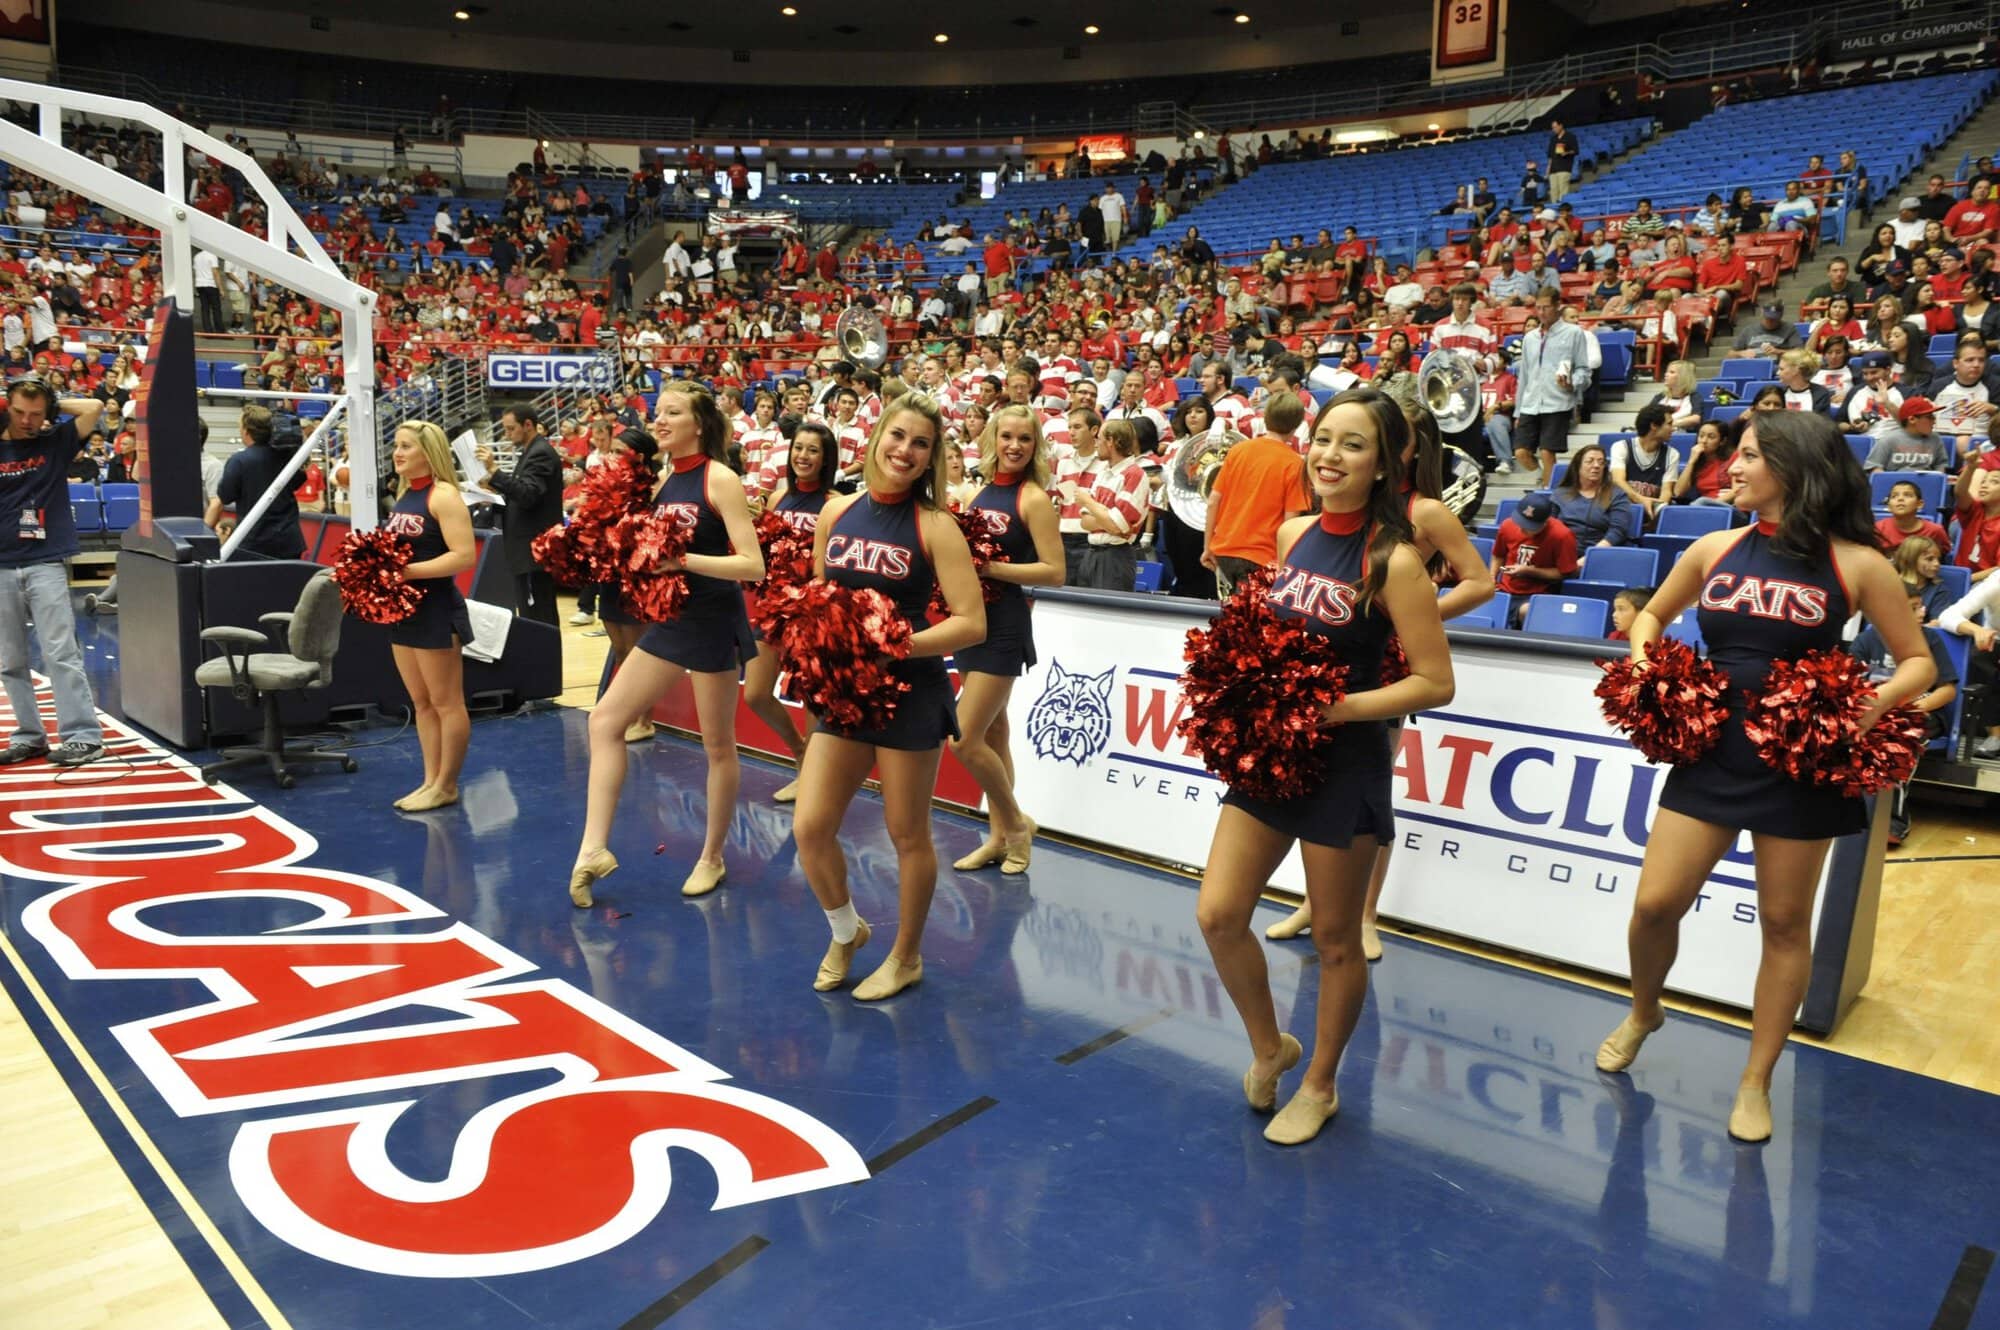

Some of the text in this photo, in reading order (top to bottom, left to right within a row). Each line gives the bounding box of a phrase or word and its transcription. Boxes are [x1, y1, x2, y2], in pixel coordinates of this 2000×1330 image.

[1456, 4, 1482, 24] 32
[1842, 18, 1986, 50] HALL OF CHAMPIONS
[491, 359, 610, 383] GEICO
[385, 511, 425, 537] ATS
[652, 503, 700, 528] ATS
[774, 509, 819, 532] ATS
[824, 533, 913, 581] CATS
[1701, 572, 1829, 627] CATS
[1507, 854, 1757, 924] COUTS
